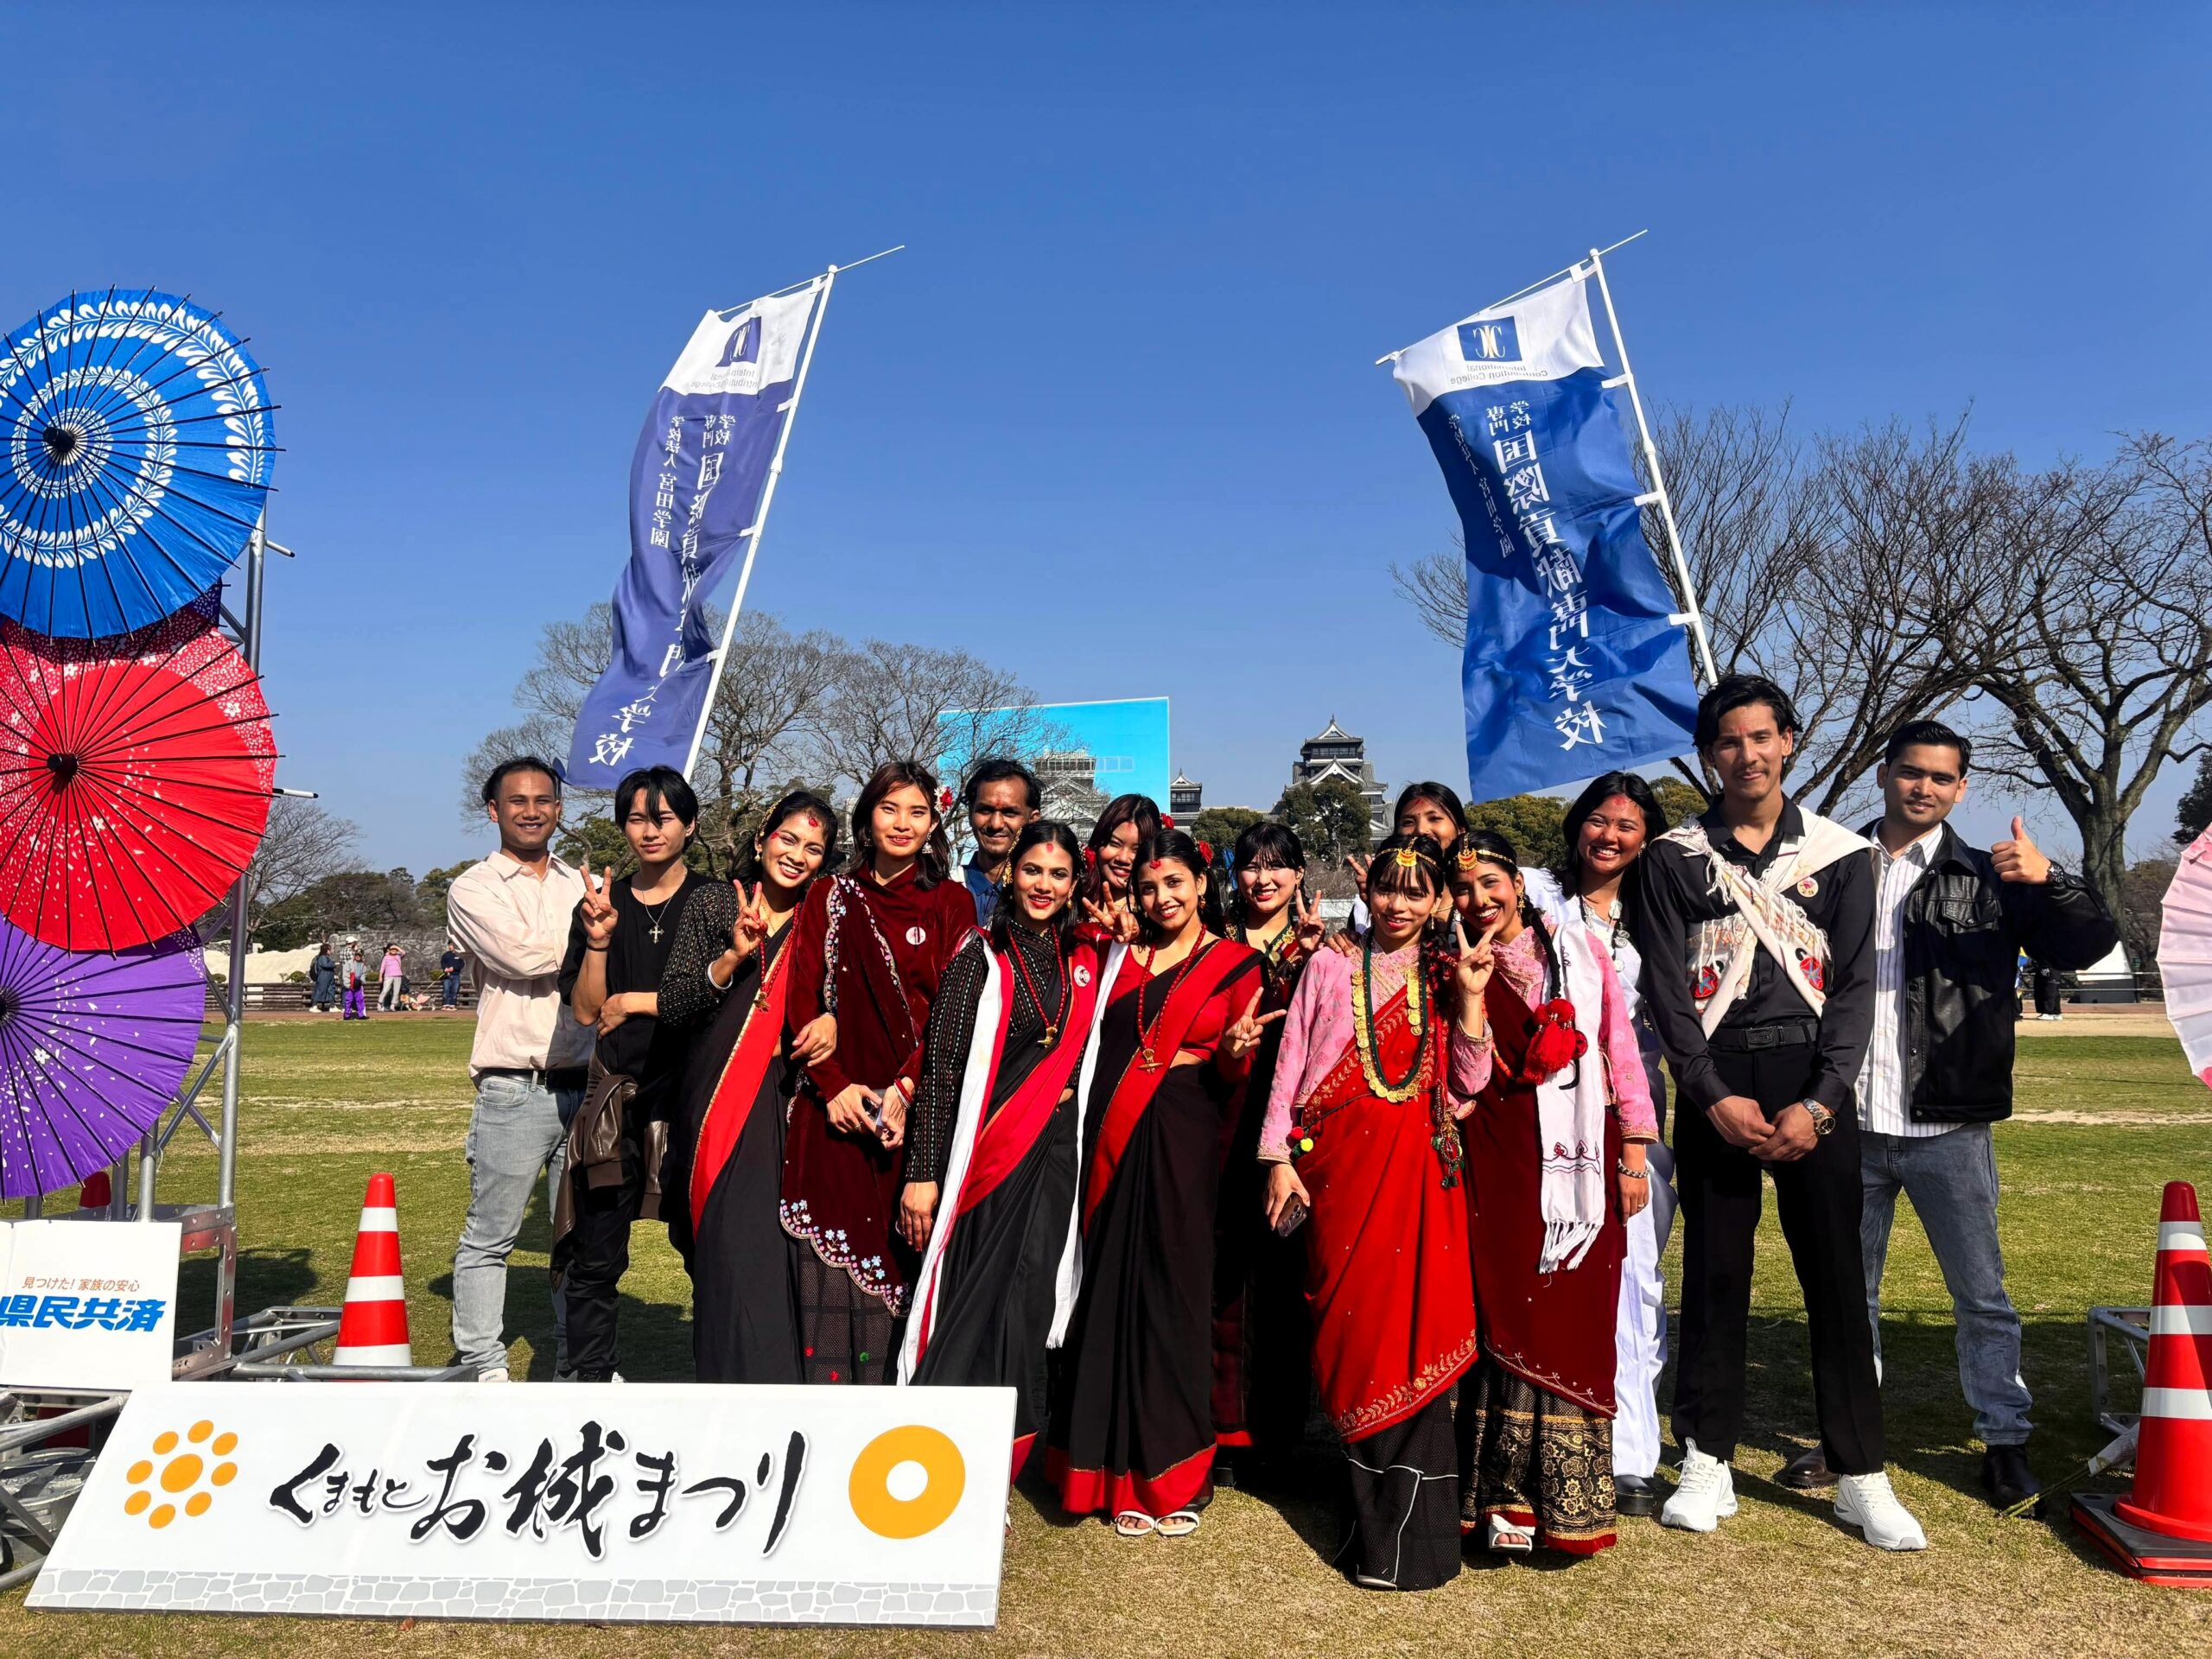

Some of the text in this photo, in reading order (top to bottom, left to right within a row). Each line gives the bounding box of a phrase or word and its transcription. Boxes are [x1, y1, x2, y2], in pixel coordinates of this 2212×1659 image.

[78, 1278, 141, 1293] 家族の安心
[0, 1294, 167, 1332] 県民共済
